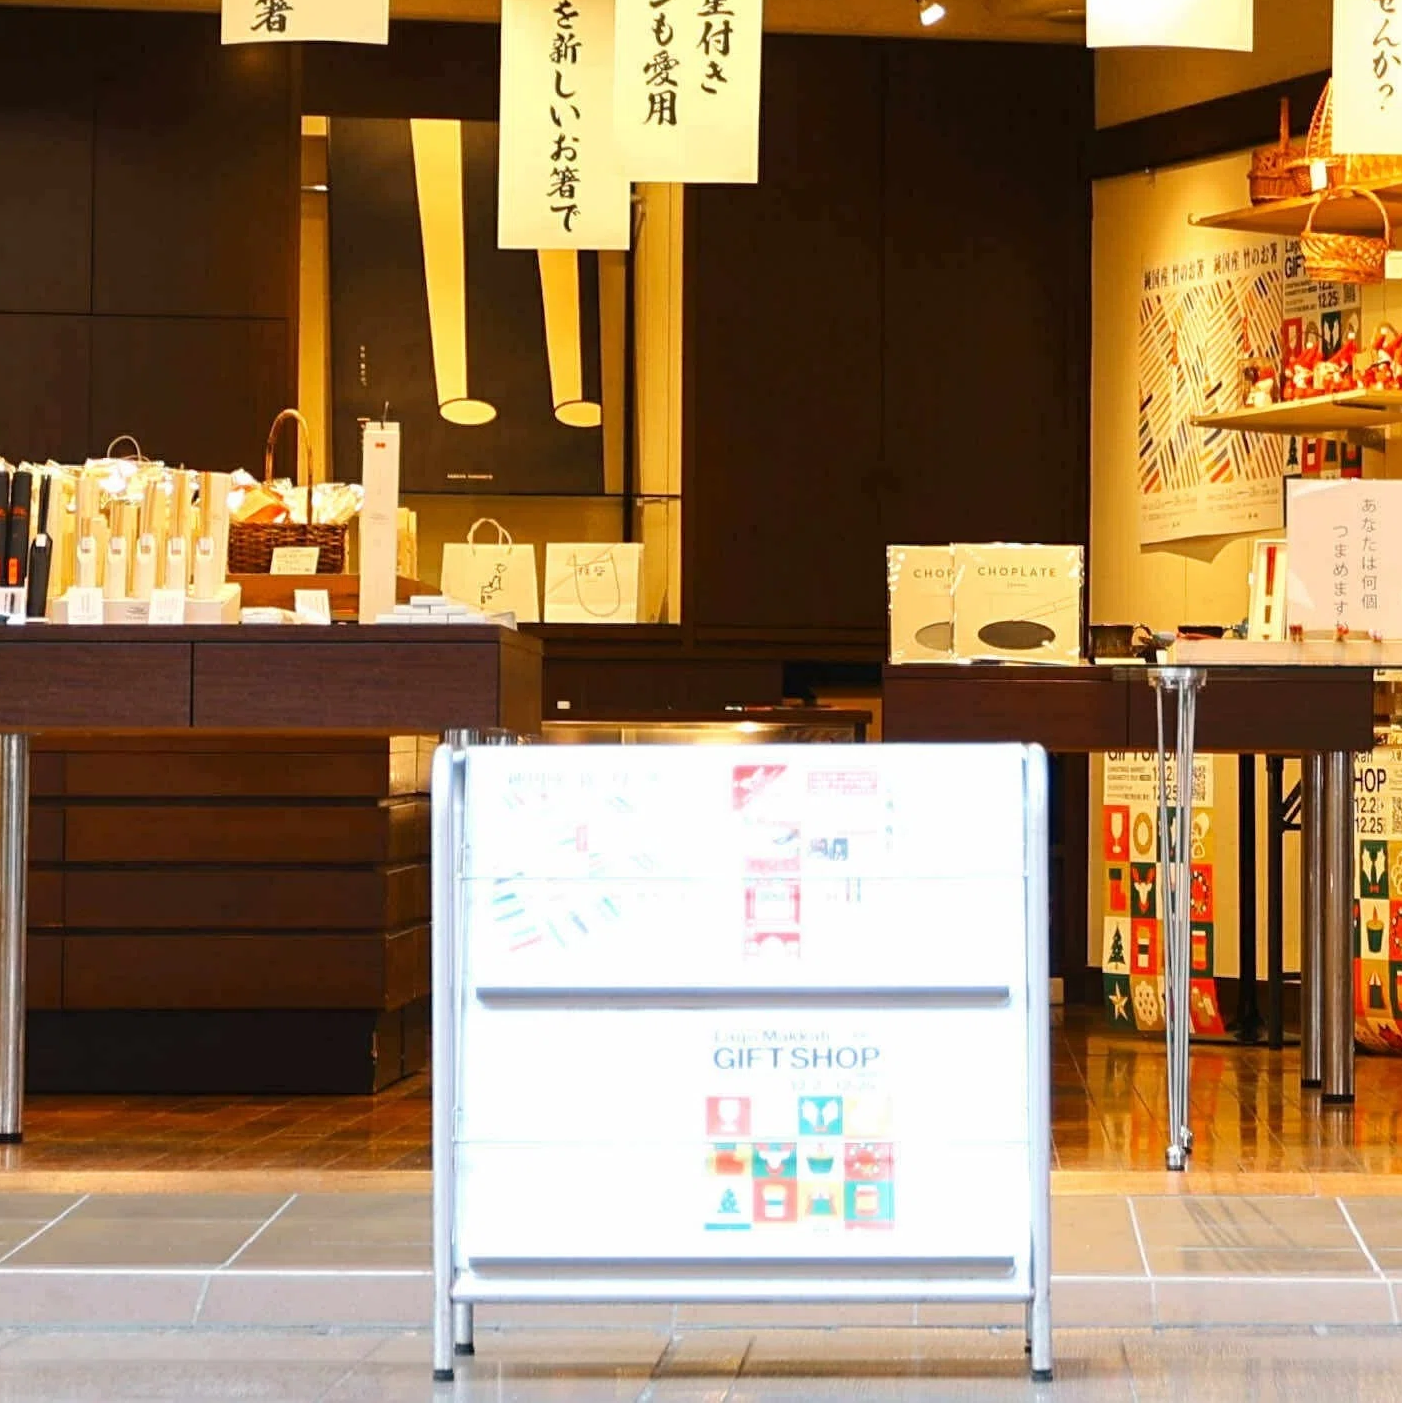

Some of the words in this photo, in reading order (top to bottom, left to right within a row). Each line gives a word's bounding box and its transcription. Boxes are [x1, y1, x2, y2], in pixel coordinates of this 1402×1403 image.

[1361, 498, 1378, 610] あなたは何個
[913, 568, 954, 579] CHOP
[977, 566, 1057, 578] CHOPLATE
[1354, 768, 1386, 792] HOP
